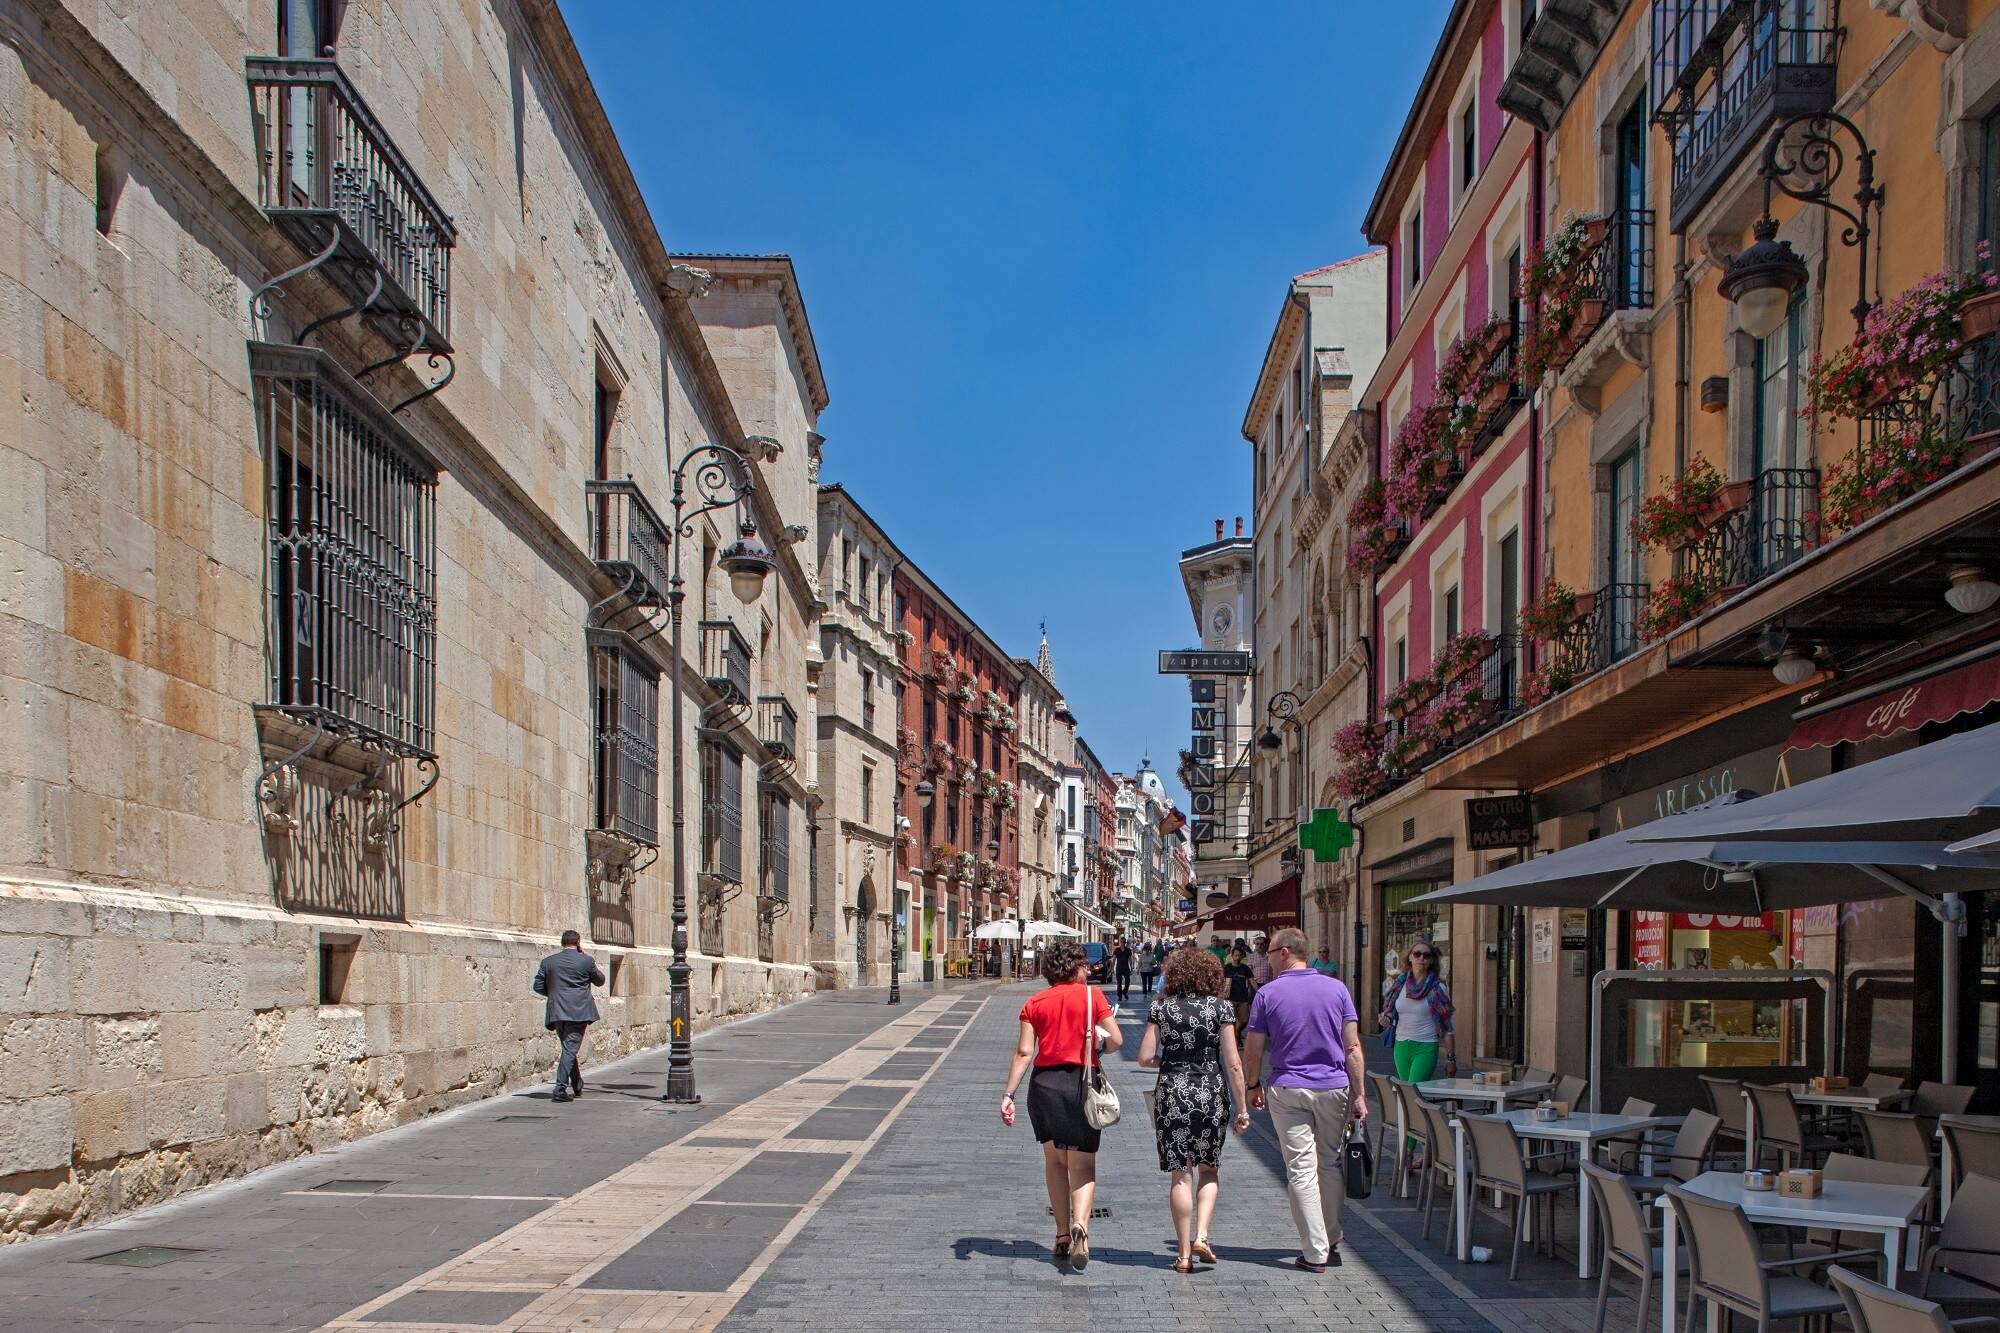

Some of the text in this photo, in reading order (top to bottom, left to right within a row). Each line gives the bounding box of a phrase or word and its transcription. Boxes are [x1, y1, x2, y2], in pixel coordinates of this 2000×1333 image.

[1169, 656, 1240, 668] zapatos
[1866, 687, 1921, 730] café
[1194, 709, 1213, 841] MUÑOZ
[1473, 799, 1525, 817] CENTRO
[1472, 829, 1530, 846] MASAJES
[1225, 913, 1265, 921] MUÑOZ
[1635, 923, 1664, 941] PROMOCIÓN
